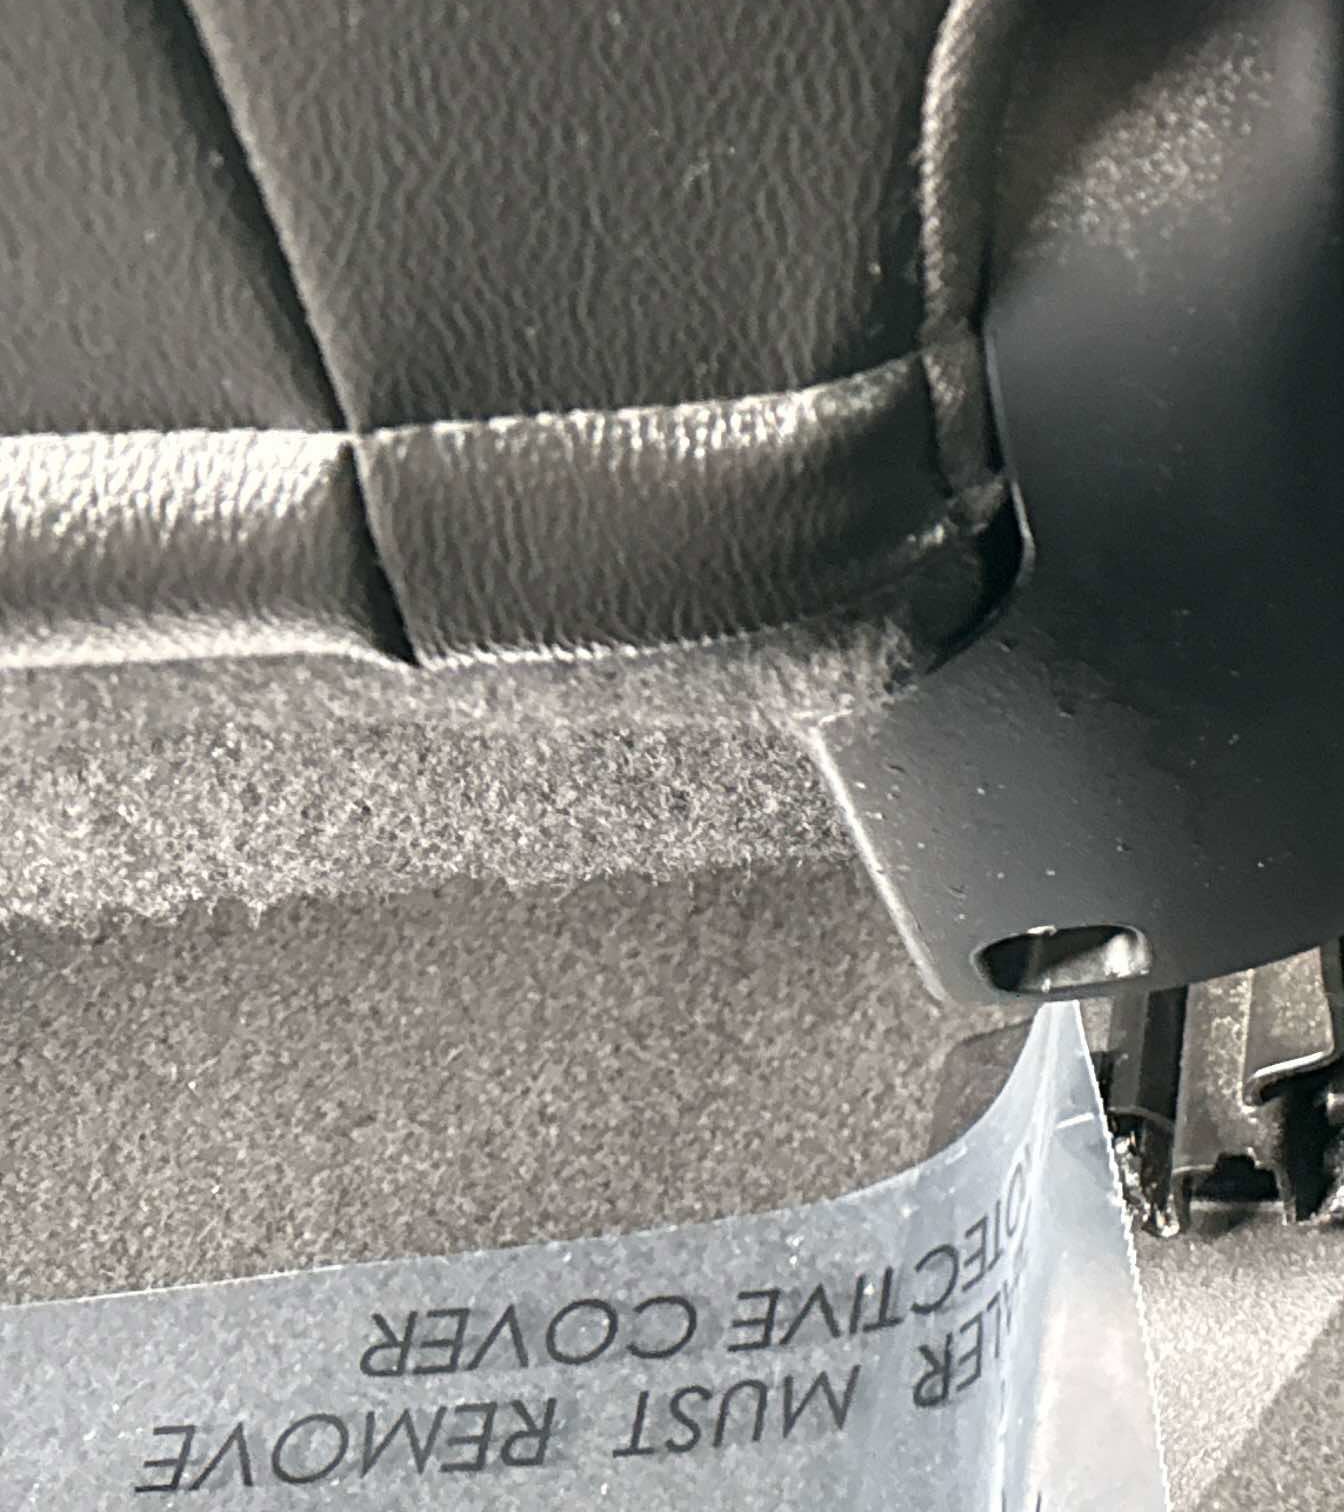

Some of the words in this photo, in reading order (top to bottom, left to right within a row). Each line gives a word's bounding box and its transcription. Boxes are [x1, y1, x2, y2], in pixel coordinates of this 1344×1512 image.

[728, 1148, 1030, 1352] OTECTIVE
[360, 1296, 697, 1377] COVER
[134, 1398, 557, 1491] REMOVE
[612, 1364, 861, 1458] MUST
